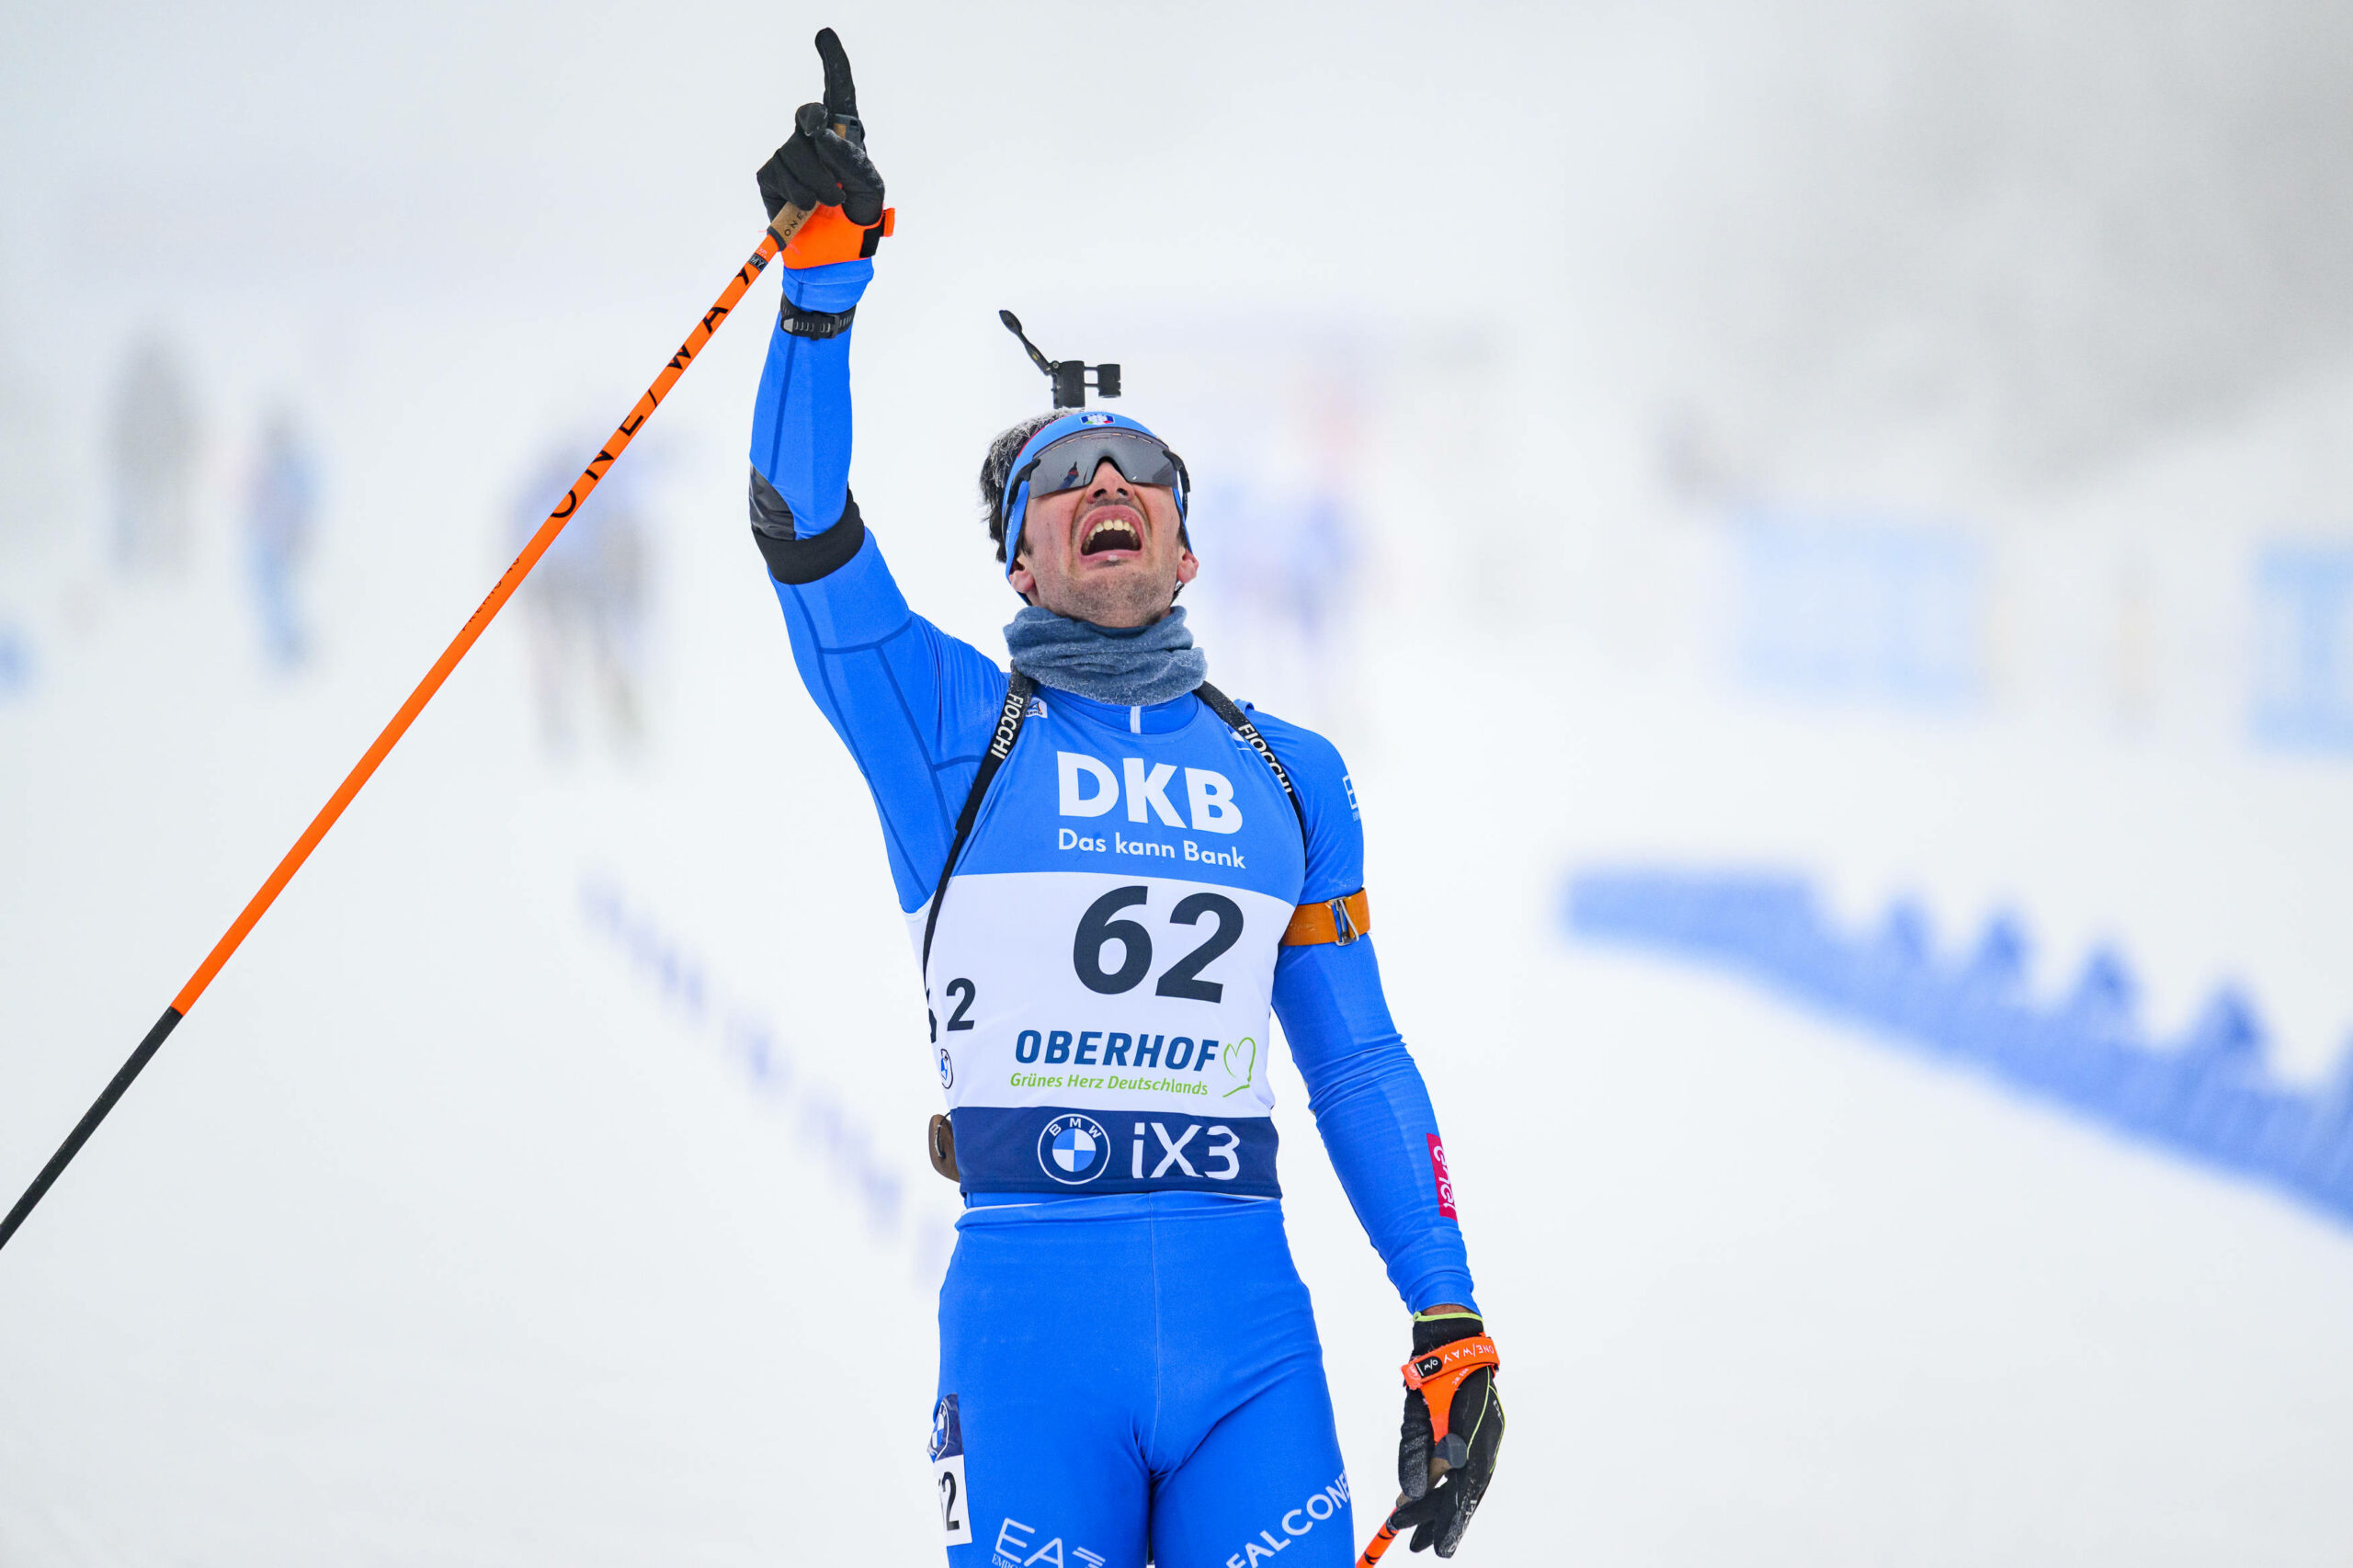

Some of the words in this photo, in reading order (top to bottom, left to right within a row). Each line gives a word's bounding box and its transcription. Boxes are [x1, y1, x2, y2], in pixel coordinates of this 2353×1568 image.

[991, 693, 1024, 759] FIOCCHI
[1057, 750, 1244, 835] DKB
[1058, 829, 1107, 852] Das
[1115, 833, 1176, 858] kann
[1184, 840, 1246, 869] Bank
[1073, 885, 1245, 1004] 62
[1015, 1029, 1219, 1072] OBERHOF
[1010, 1073, 1063, 1087] Grünes
[1067, 1074, 1103, 1089] Herz
[1108, 1075, 1209, 1096] Deutschlands
[1049, 1118, 1101, 1138] BMW
[1131, 1122, 1240, 1180] iX3
[1444, 1343, 1495, 1364] ONE/WAY
